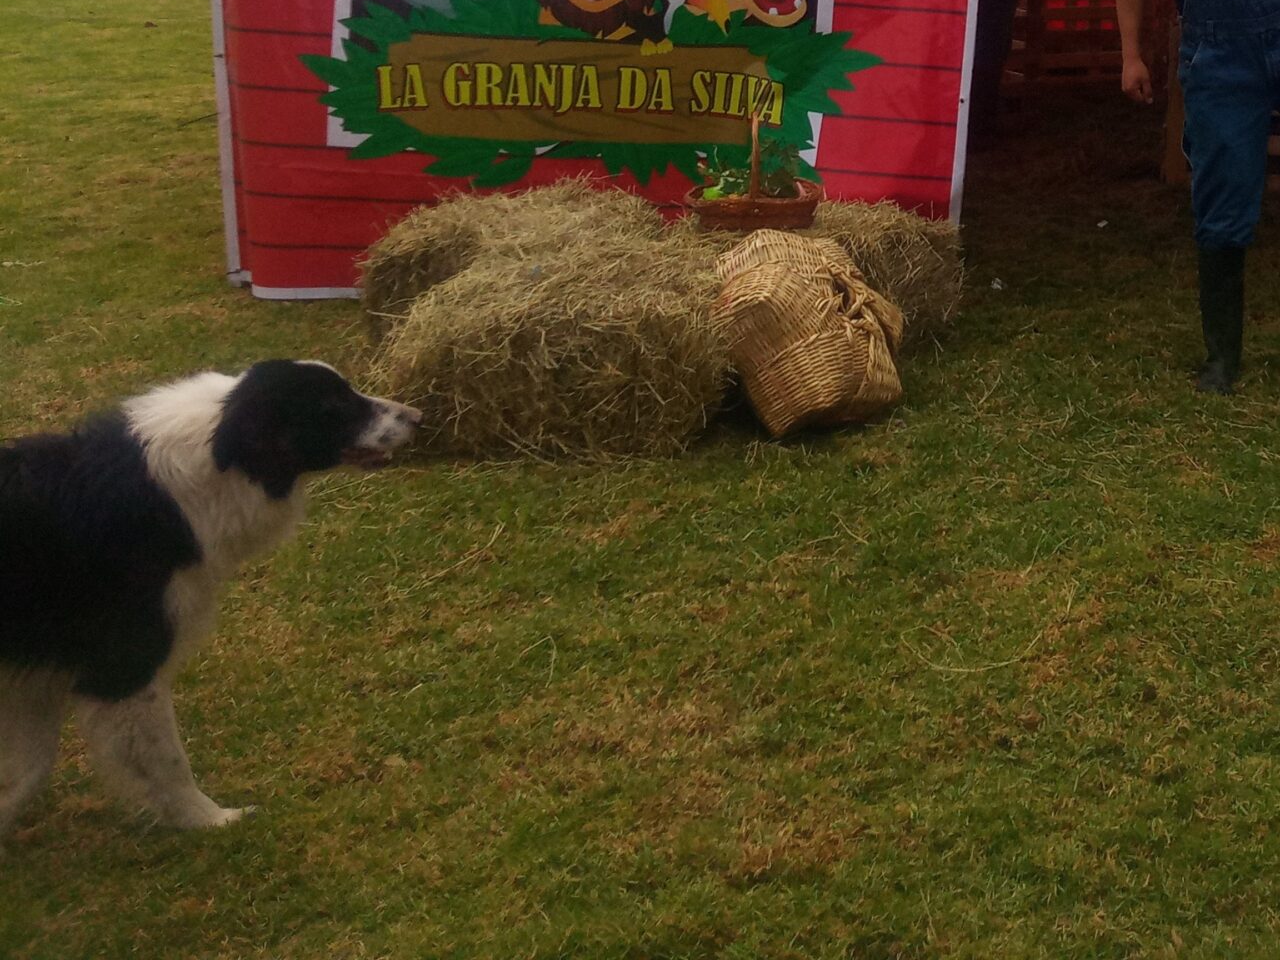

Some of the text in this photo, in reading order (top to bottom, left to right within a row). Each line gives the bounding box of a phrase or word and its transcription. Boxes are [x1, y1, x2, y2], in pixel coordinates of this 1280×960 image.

[376, 63, 785, 125] LA GRANJA DA SILVA
